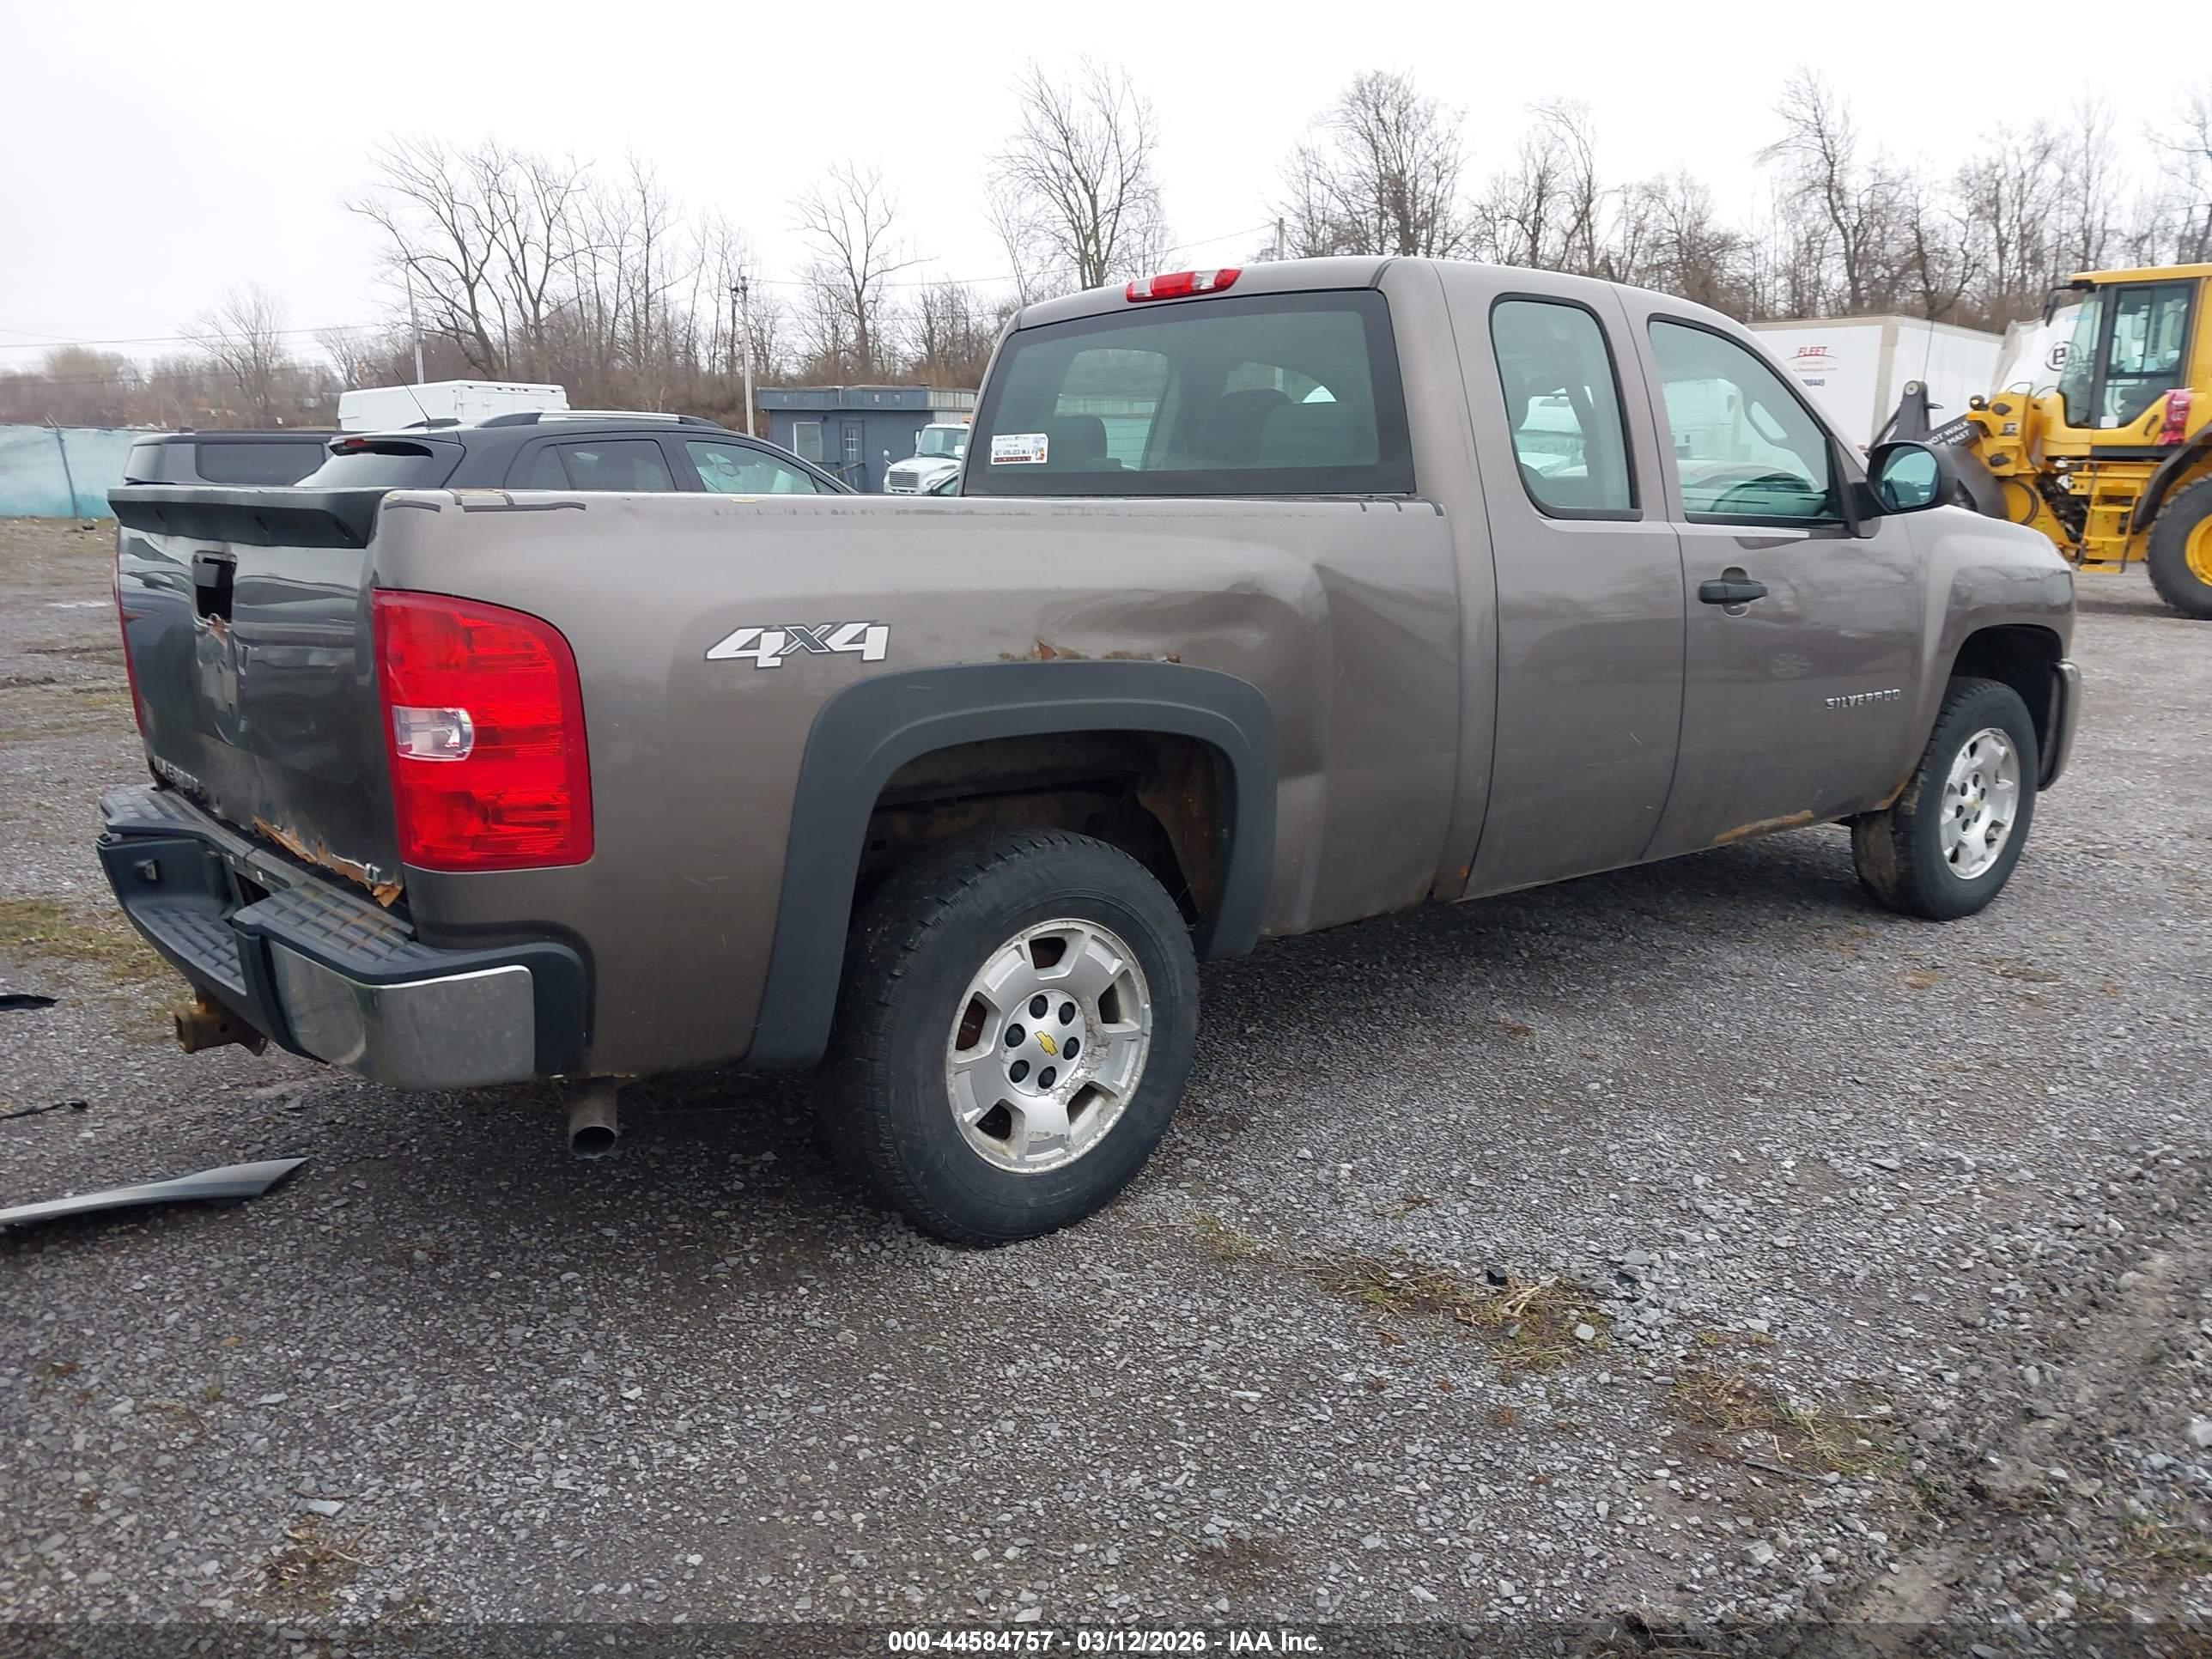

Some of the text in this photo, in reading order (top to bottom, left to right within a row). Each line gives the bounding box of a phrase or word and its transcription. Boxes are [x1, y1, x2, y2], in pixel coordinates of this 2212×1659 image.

[1798, 346, 1828, 357] FLEET
[1944, 421, 1971, 436] WALK
[1826, 688, 1901, 709] SILVERADO
